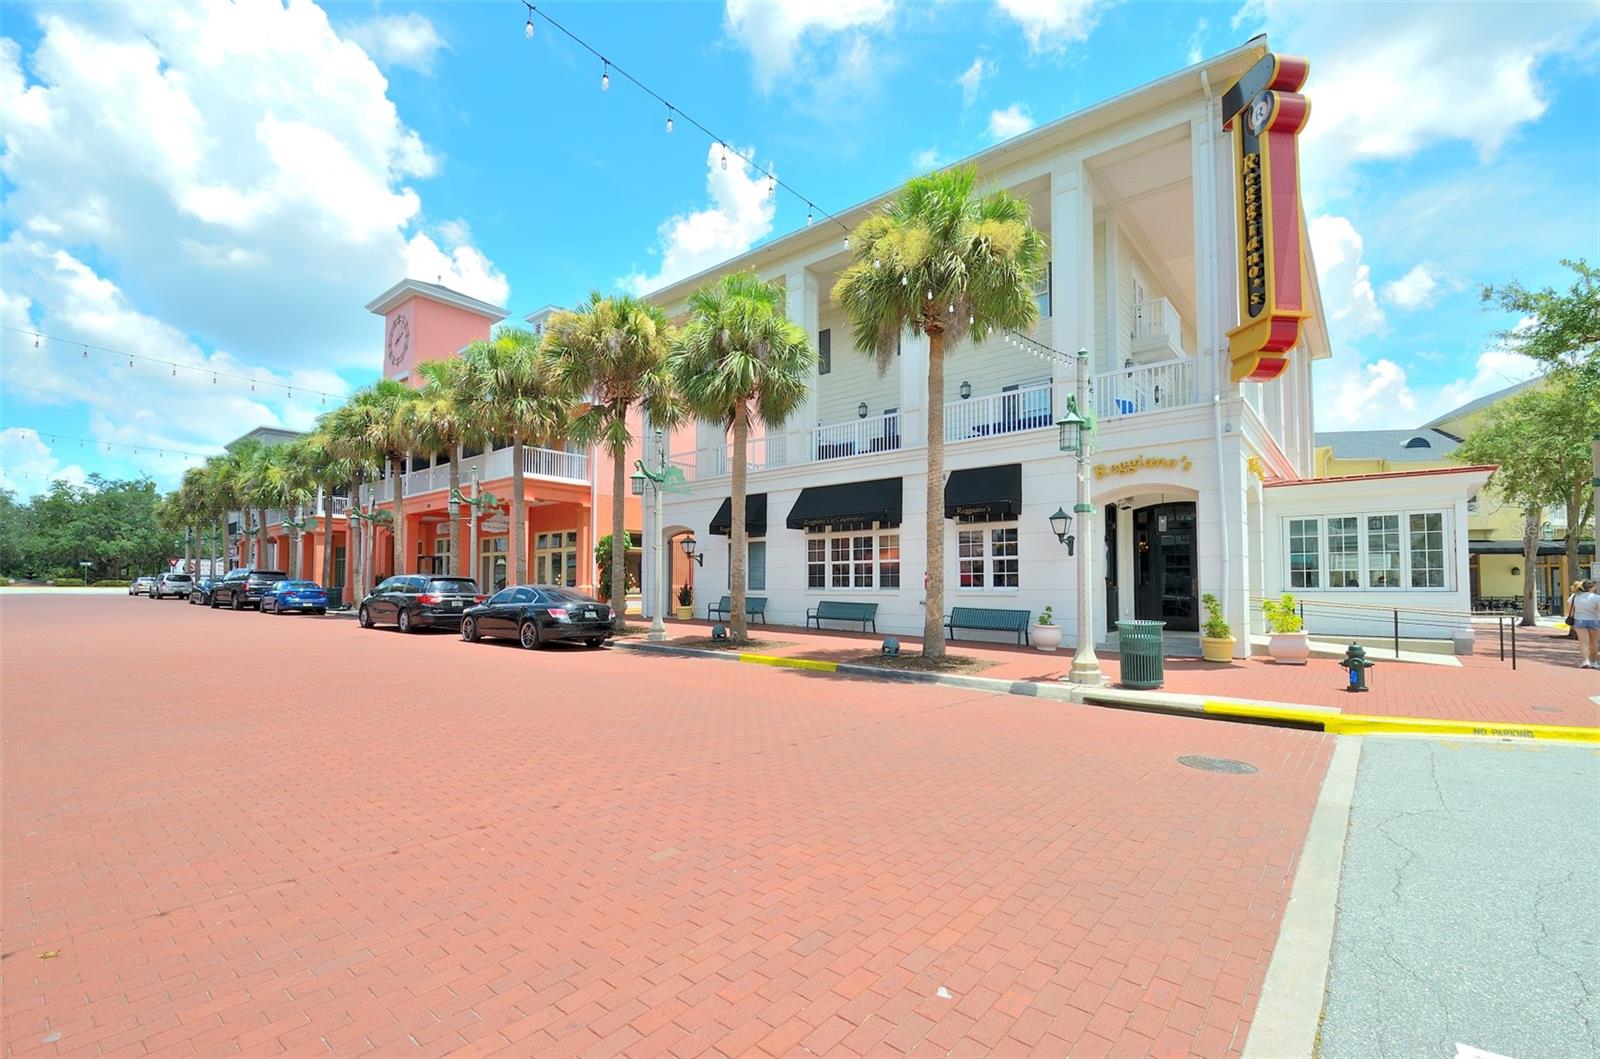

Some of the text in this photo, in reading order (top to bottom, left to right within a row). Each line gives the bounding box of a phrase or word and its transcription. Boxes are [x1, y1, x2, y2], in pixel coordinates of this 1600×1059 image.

[1243, 153, 1261, 305] Reggiano's
[1093, 454, 1192, 480] Reggiano's
[1472, 727, 1535, 738] NO PARKING
